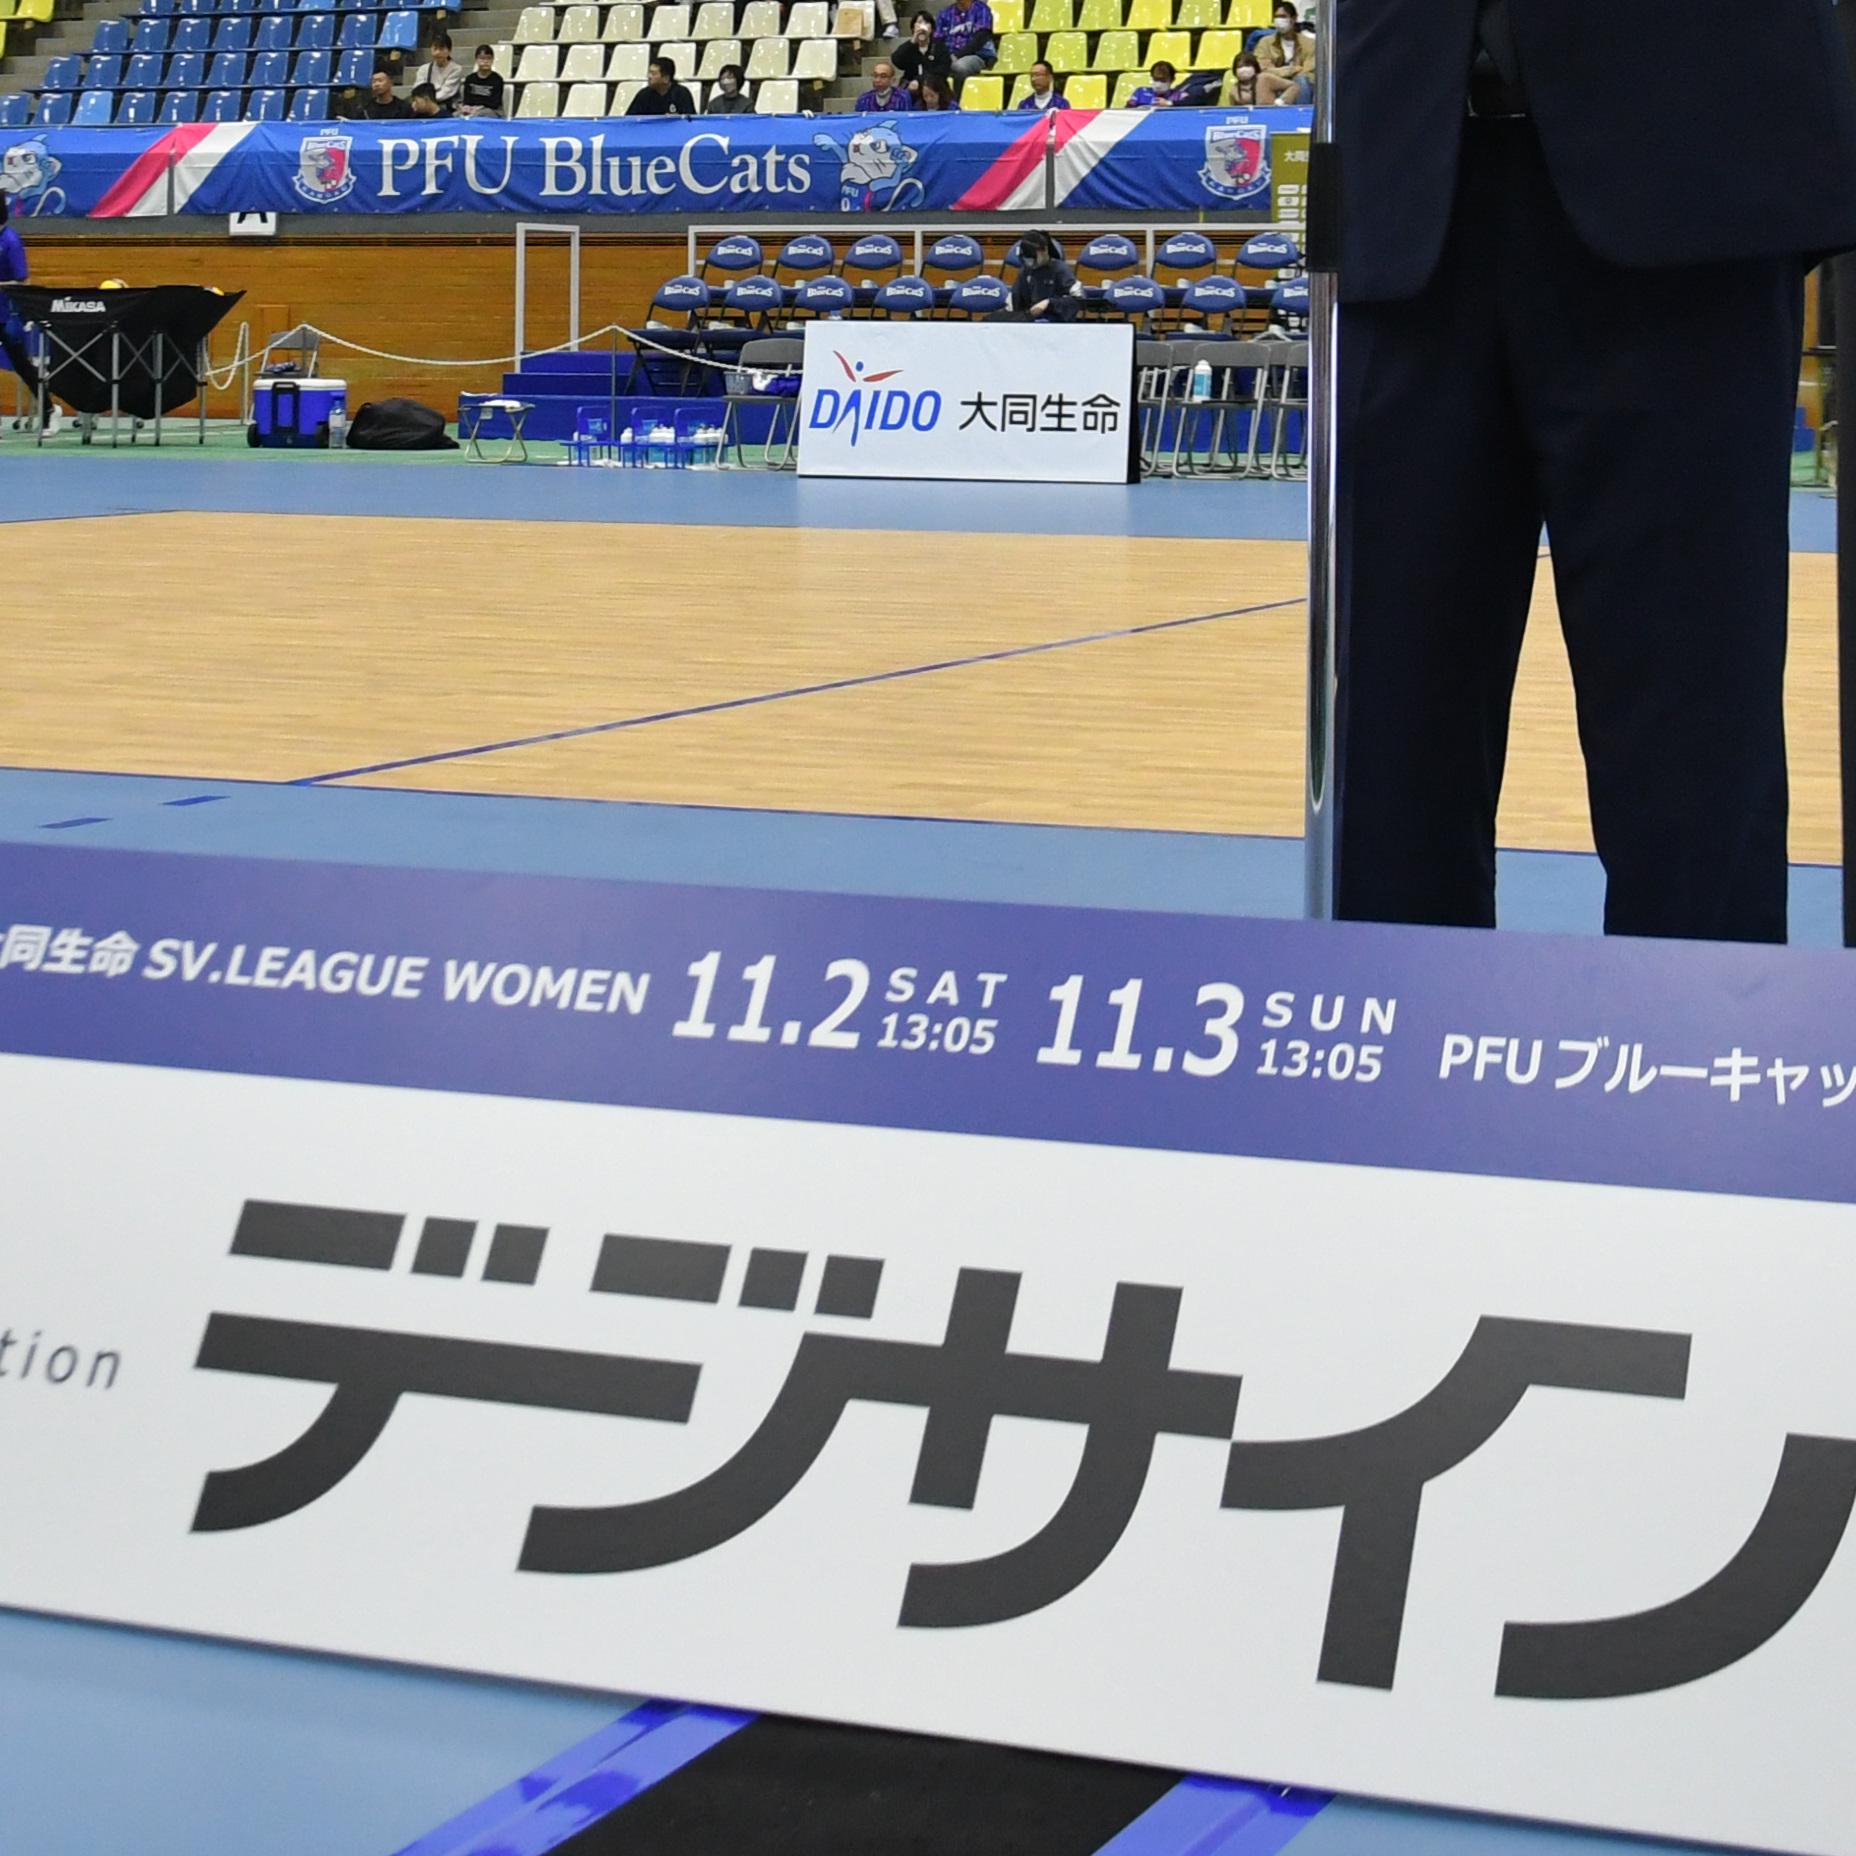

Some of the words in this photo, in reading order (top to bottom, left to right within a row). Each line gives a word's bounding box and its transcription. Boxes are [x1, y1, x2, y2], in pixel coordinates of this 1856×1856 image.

[376, 134, 519, 196] PFU
[537, 132, 813, 197] BlueCats
[808, 387, 942, 448] DAIDO
[958, 391, 1121, 435] 大同生命
[141, 941, 430, 999] SV.LEAGUE
[441, 962, 652, 1017] WOMEN
[671, 950, 872, 1050] 11.2
[886, 966, 1009, 1009] SAT
[876, 1012, 999, 1056] 13:05
[1034, 973, 1246, 1078] 11.3
[1260, 991, 1398, 1036] SUN
[1254, 1041, 1385, 1084] 13:05
[1436, 1032, 1544, 1087] PFU
